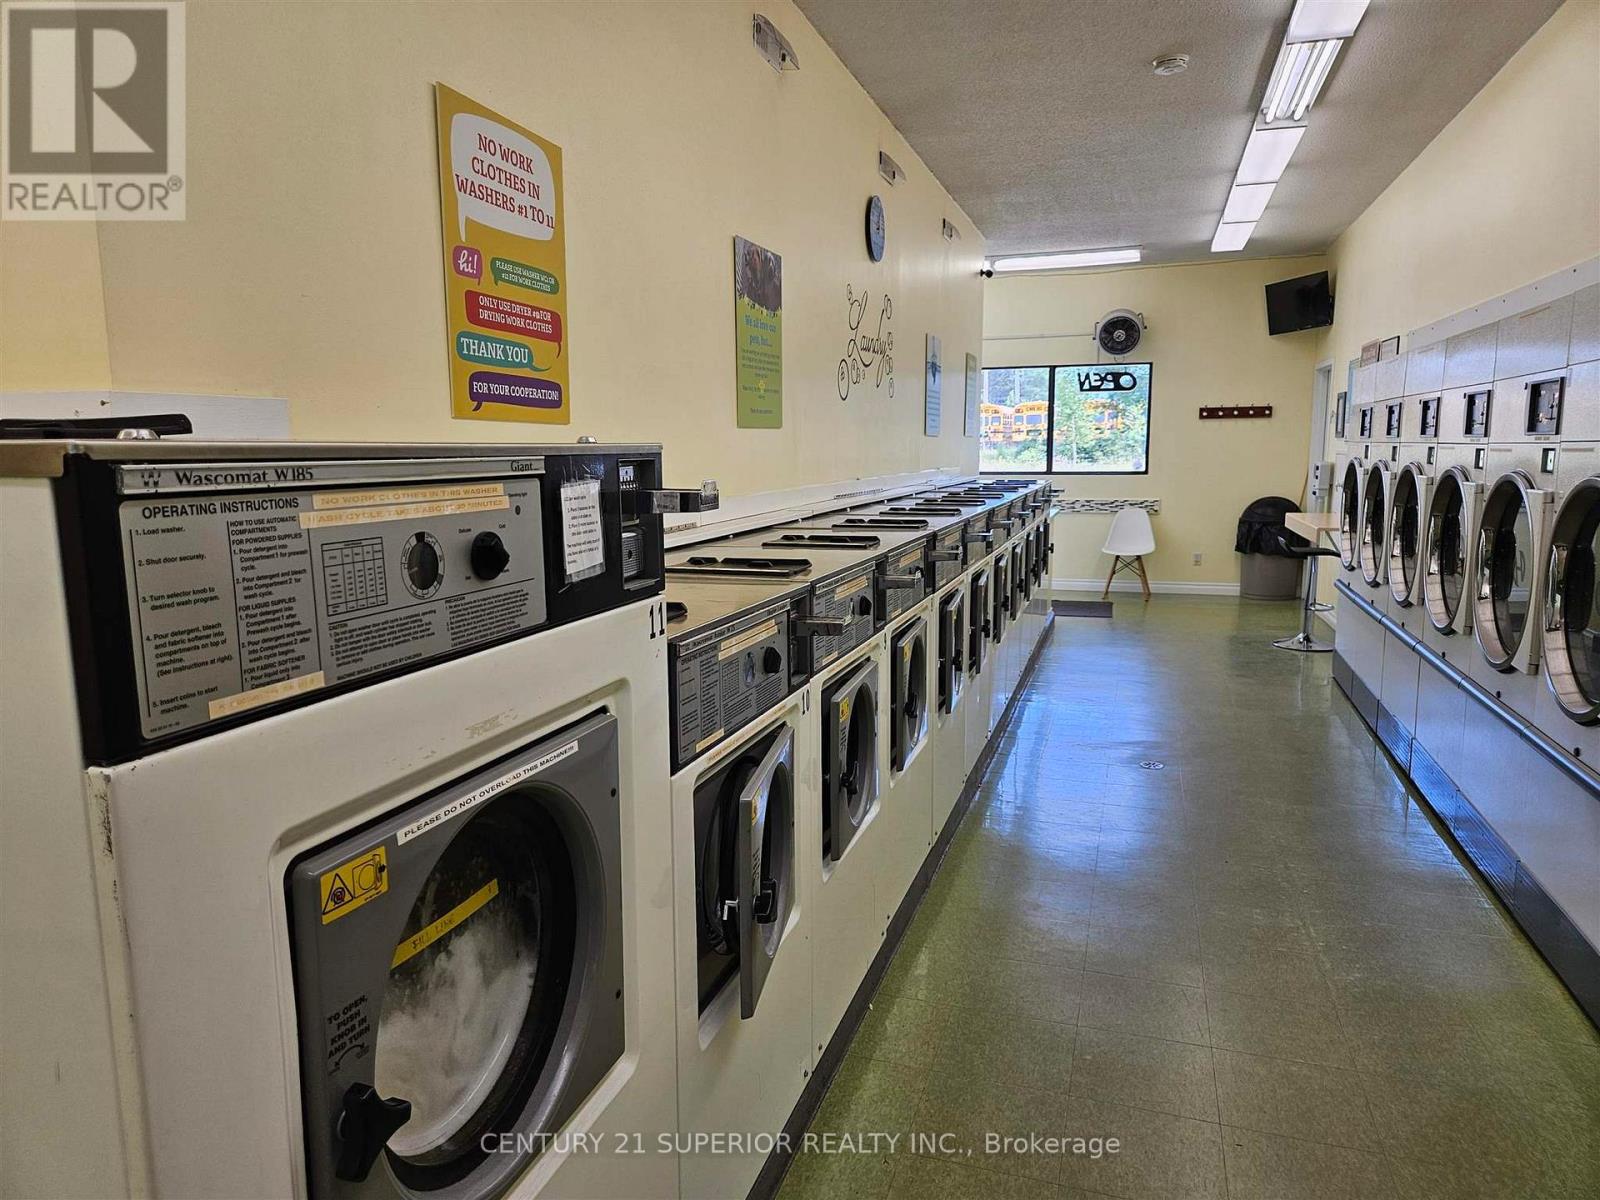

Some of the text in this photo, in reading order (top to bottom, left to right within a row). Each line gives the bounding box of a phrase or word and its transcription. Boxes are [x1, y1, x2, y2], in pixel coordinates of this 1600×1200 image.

[477, 133, 534, 175] NO WORK
[471, 156, 540, 200] CLOTHES IN
[455, 173, 555, 229] WASHERS #1 TO 11
[458, 250, 477, 275] hi!
[496, 260, 513, 272] PLEASE
[514, 266, 522, 274] USE
[522, 269, 540, 280] WASHER
[510, 274, 518, 283] FOR
[518, 276, 530, 286] WORK
[532, 280, 550, 292] CLOTHES
[479, 296, 498, 309] ONLY
[499, 300, 511, 312] USE
[512, 304, 532, 317] DRYER
[540, 310, 552, 322] FOR
[479, 309, 552, 334] DRYING WORK CLOTHES
[847, 290, 889, 388] Laundry
[461, 338, 528, 364] THANK YOU
[474, 381, 559, 401] FOR YOUR COOPERATION!
[510, 460, 534, 472] Giant
[175, 468, 314, 486] Wascomat W185
[142, 498, 299, 520] OPERATING INSTRUCTIONS
[321, 497, 338, 505] NO
[343, 494, 376, 504] WORK
[266, 516, 297, 524] AUTOMATIC
[143, 528, 160, 536] Load
[161, 526, 186, 534] washer.
[231, 526, 277, 536] COMPARTMENTS
[245, 535, 276, 544] POWDERED
[178, 553, 206, 561] securely.
[254, 544, 278, 553] detergent
[166, 590, 191, 599] selector
[150, 602, 175, 611] desired
[176, 598, 192, 606] wash
[202, 622, 222, 631] bleach
[649, 601, 665, 640] 11
[154, 642, 167, 650] and
[168, 638, 186, 648] fabric
[187, 633, 212, 642] softener
[155, 644, 200, 659] compartments
[210, 640, 220, 648] top
[157, 668, 172, 678] (See
[172, 660, 208, 672] instructions
[160, 696, 178, 706] Insert
[180, 692, 196, 701] coins
[204, 686, 218, 694] start
[404, 813, 442, 838] PLEASE
[444, 806, 458, 817] DO
[460, 794, 478, 808] NOT
[478, 772, 522, 798] OVERLOAD
[522, 763, 539, 775] THIS
[327, 1012, 341, 1024] TO
[336, 1009, 362, 1031] PUSH
[330, 1016, 368, 1046] KNOB IN
[328, 1024, 370, 1059] AND TURN
